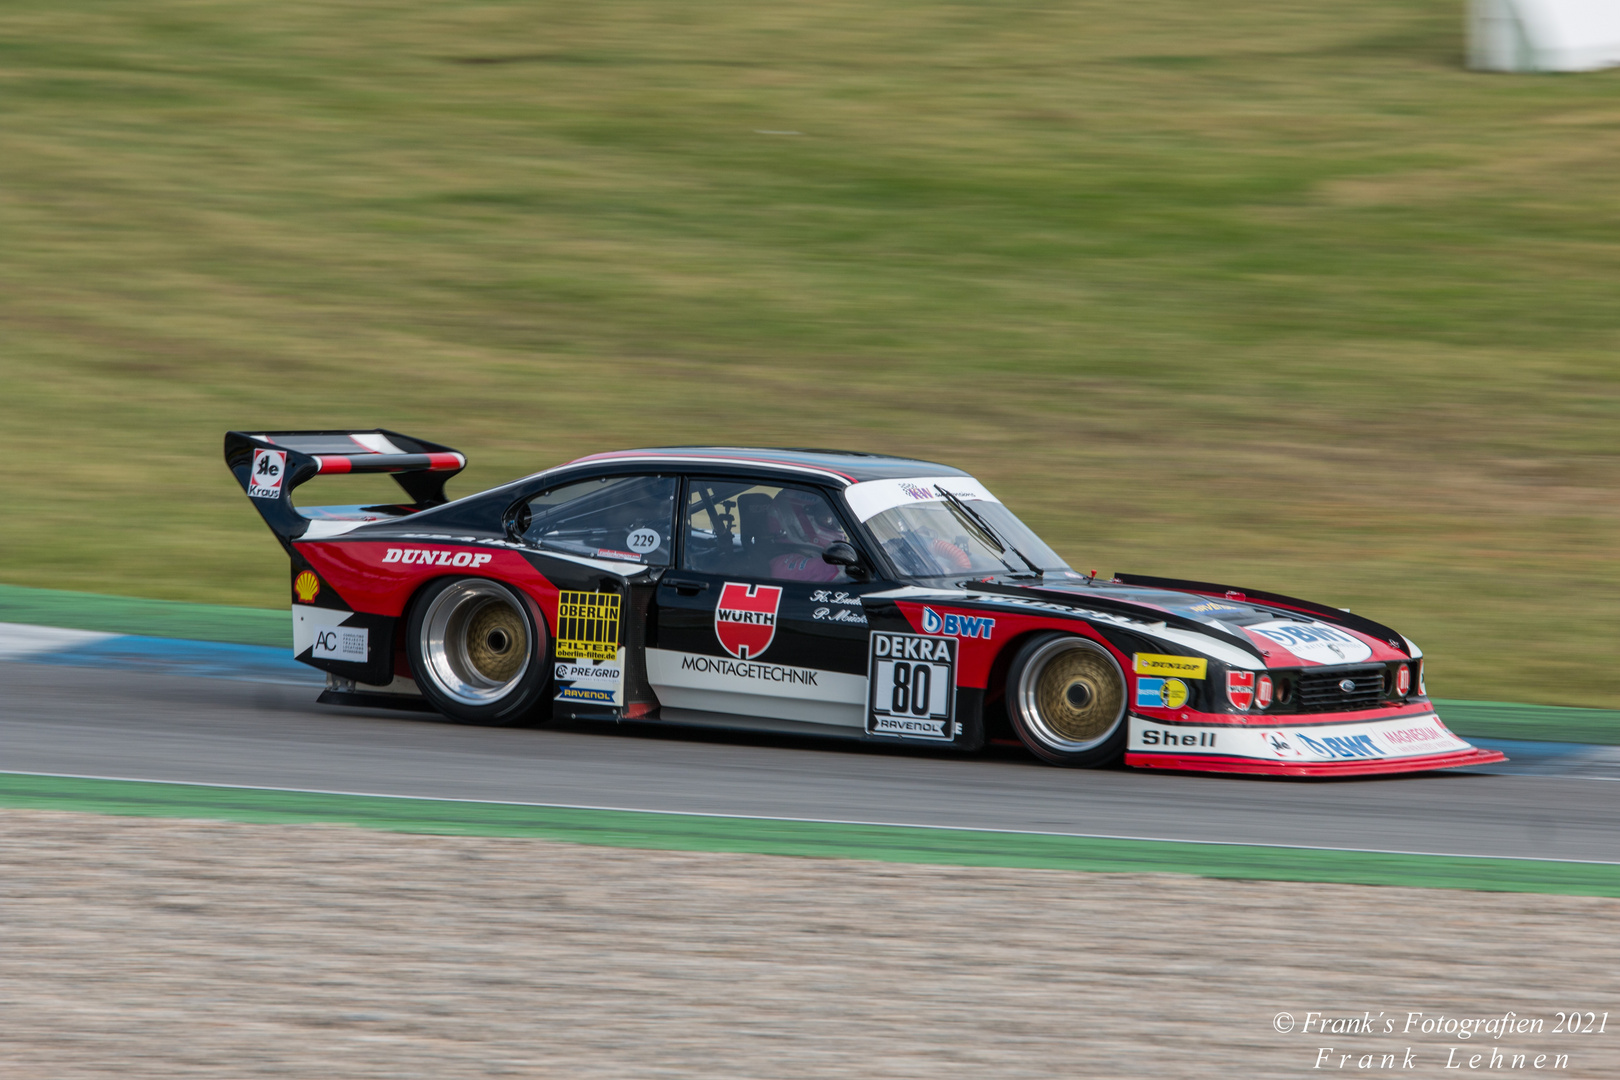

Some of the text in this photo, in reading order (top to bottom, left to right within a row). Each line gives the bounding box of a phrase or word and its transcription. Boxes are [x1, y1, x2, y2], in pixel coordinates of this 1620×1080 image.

[249, 485, 280, 498] Kraus
[908, 487, 934, 500] KW
[632, 534, 655, 547] 229
[382, 548, 492, 568] DUNLOP
[560, 604, 618, 620] OBERLIN
[718, 609, 775, 625] WÜRTH
[943, 613, 996, 640] BWT
[1279, 625, 1352, 643] BWT
[315, 630, 337, 651] AC
[558, 642, 616, 652] FILTER
[875, 635, 952, 662] DEKRA
[557, 651, 616, 660] oberlin-filter.de
[570, 667, 620, 679] PRE/GRID
[681, 656, 819, 686] MONTAGETECHNIK
[1151, 661, 1200, 671] DUNLOP
[564, 689, 611, 700] RAVENOL
[892, 662, 931, 716] 80
[880, 719, 940, 732] RAVENOL
[1142, 729, 1217, 748] Shell
[1382, 726, 1444, 745] MAGNESIUM
[1321, 734, 1387, 758] BWT
